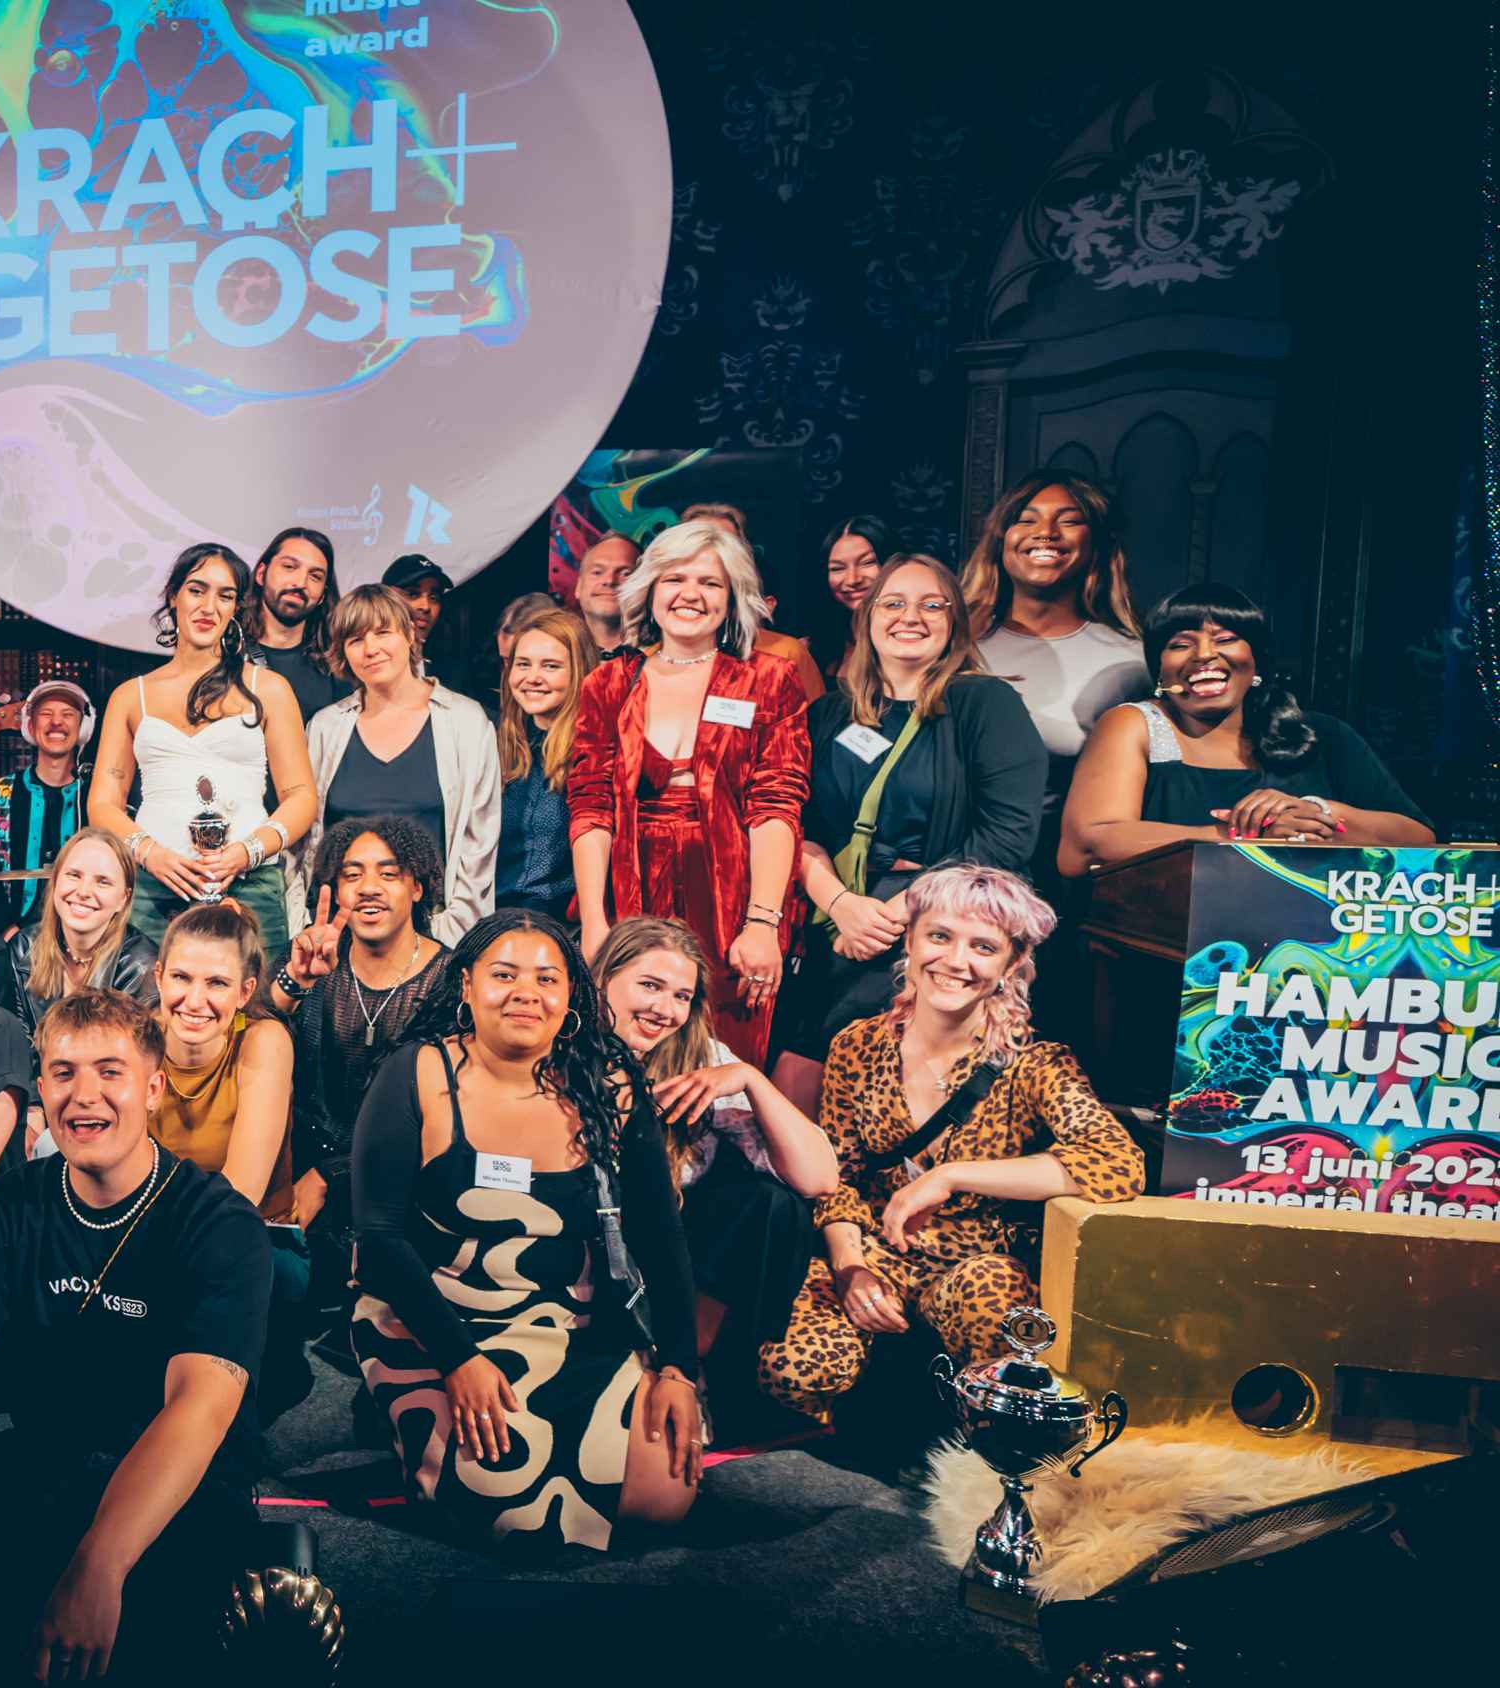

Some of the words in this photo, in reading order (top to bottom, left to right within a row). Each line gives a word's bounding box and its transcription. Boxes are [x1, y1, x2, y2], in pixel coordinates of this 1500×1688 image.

[305, 0, 421, 17] mus
[304, 16, 429, 57] award
[1215, 971, 1500, 1028] HAMBU
[1280, 1026, 1500, 1083] MUSIC
[1241, 1145, 1294, 1175] 13.
[1302, 1147, 1393, 1184] juni
[1405, 1154, 1500, 1187] 202
[1390, 1192, 1500, 1221] thea
